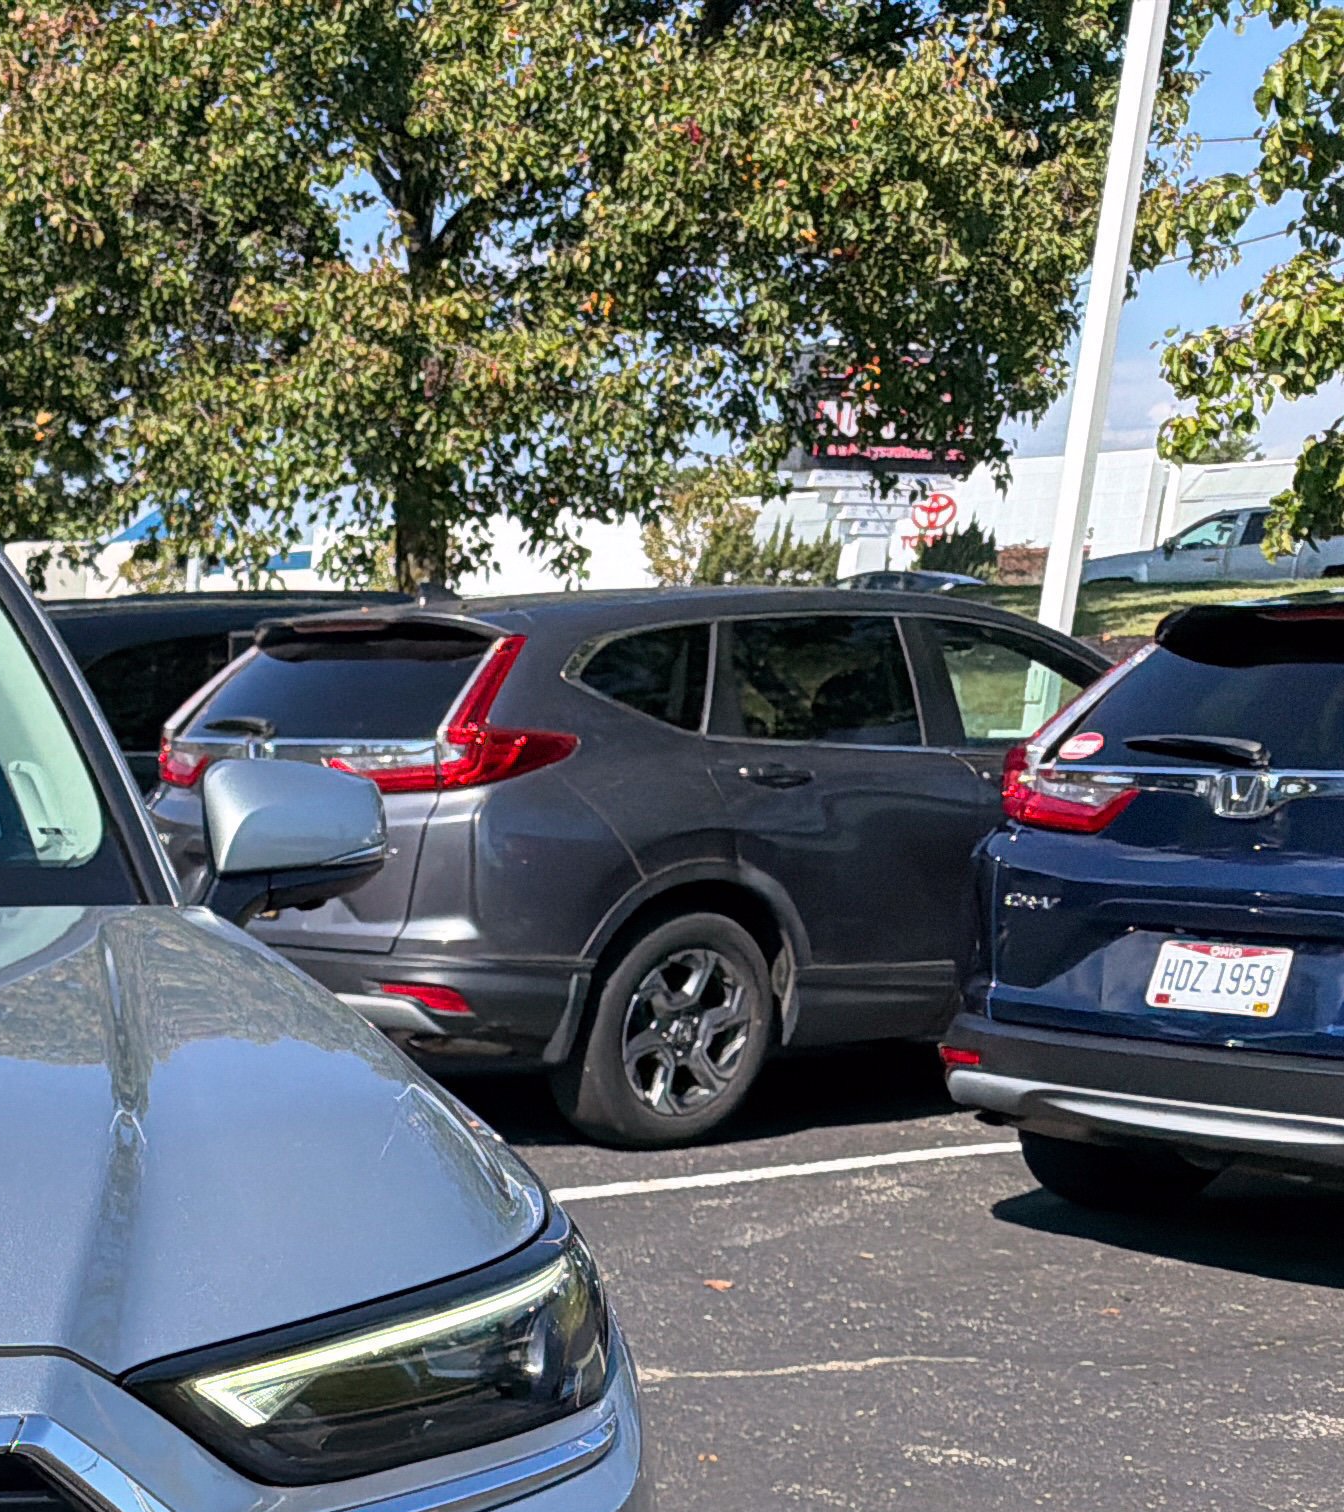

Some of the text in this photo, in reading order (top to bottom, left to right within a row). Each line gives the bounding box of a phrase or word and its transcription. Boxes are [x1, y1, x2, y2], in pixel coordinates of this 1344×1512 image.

[1209, 945, 1243, 959] OHIO
[1159, 958, 1276, 997] HDZ 1959
